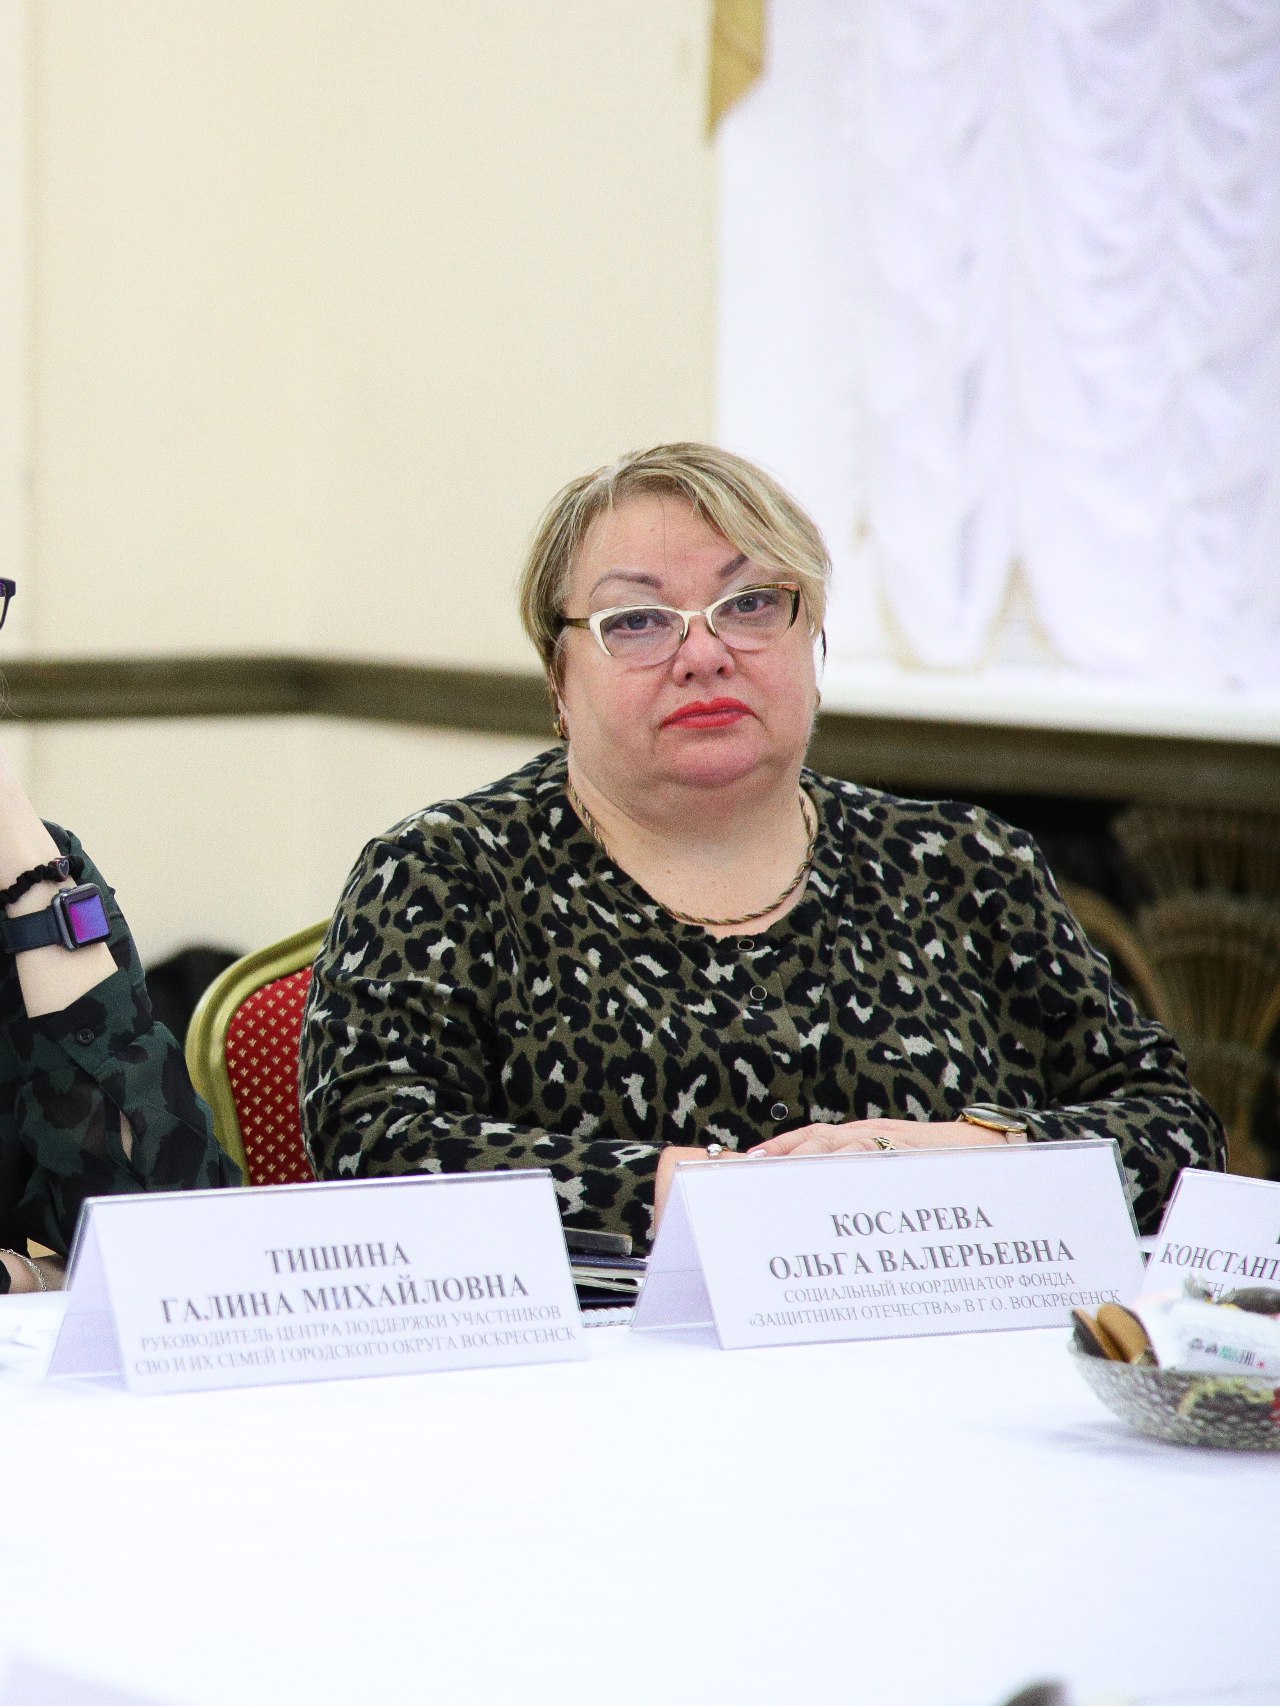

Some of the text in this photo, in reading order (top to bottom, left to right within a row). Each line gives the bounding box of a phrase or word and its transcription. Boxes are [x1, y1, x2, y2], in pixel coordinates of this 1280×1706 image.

[830, 1204, 994, 1237] КОСАРЕВА
[265, 1240, 411, 1275] ТИШИНА
[770, 1238, 1076, 1280] ОЛЬГА ВАЛЕРЬЕВНА
[1160, 1241, 1280, 1282] КОНСТАНТ
[160, 1272, 531, 1324] ГАЛИНА МИХАЙЛОВНА
[749, 1306, 858, 1328] «ЗАЩИТНИКИ
[861, 1298, 961, 1320] ОТЕЧЕСТВА»
[1011, 1288, 1123, 1311] ВОСКРЕСЕНСК
[784, 1270, 1077, 1305] СОЦИАЛЬНЫЙ КООРДИНАТОР ФОНДА
[140, 1304, 562, 1352] РУКОВОДИТЕЛЬ ЦЕНТРА ПОДДЕРЖКИ УЧАСТНИКОВ
[134, 1326, 577, 1377] СВО И ИХ СЕМЕЙ ГОРОДСКОГО ОКРУГА ВОСКРЕСЕНСК
